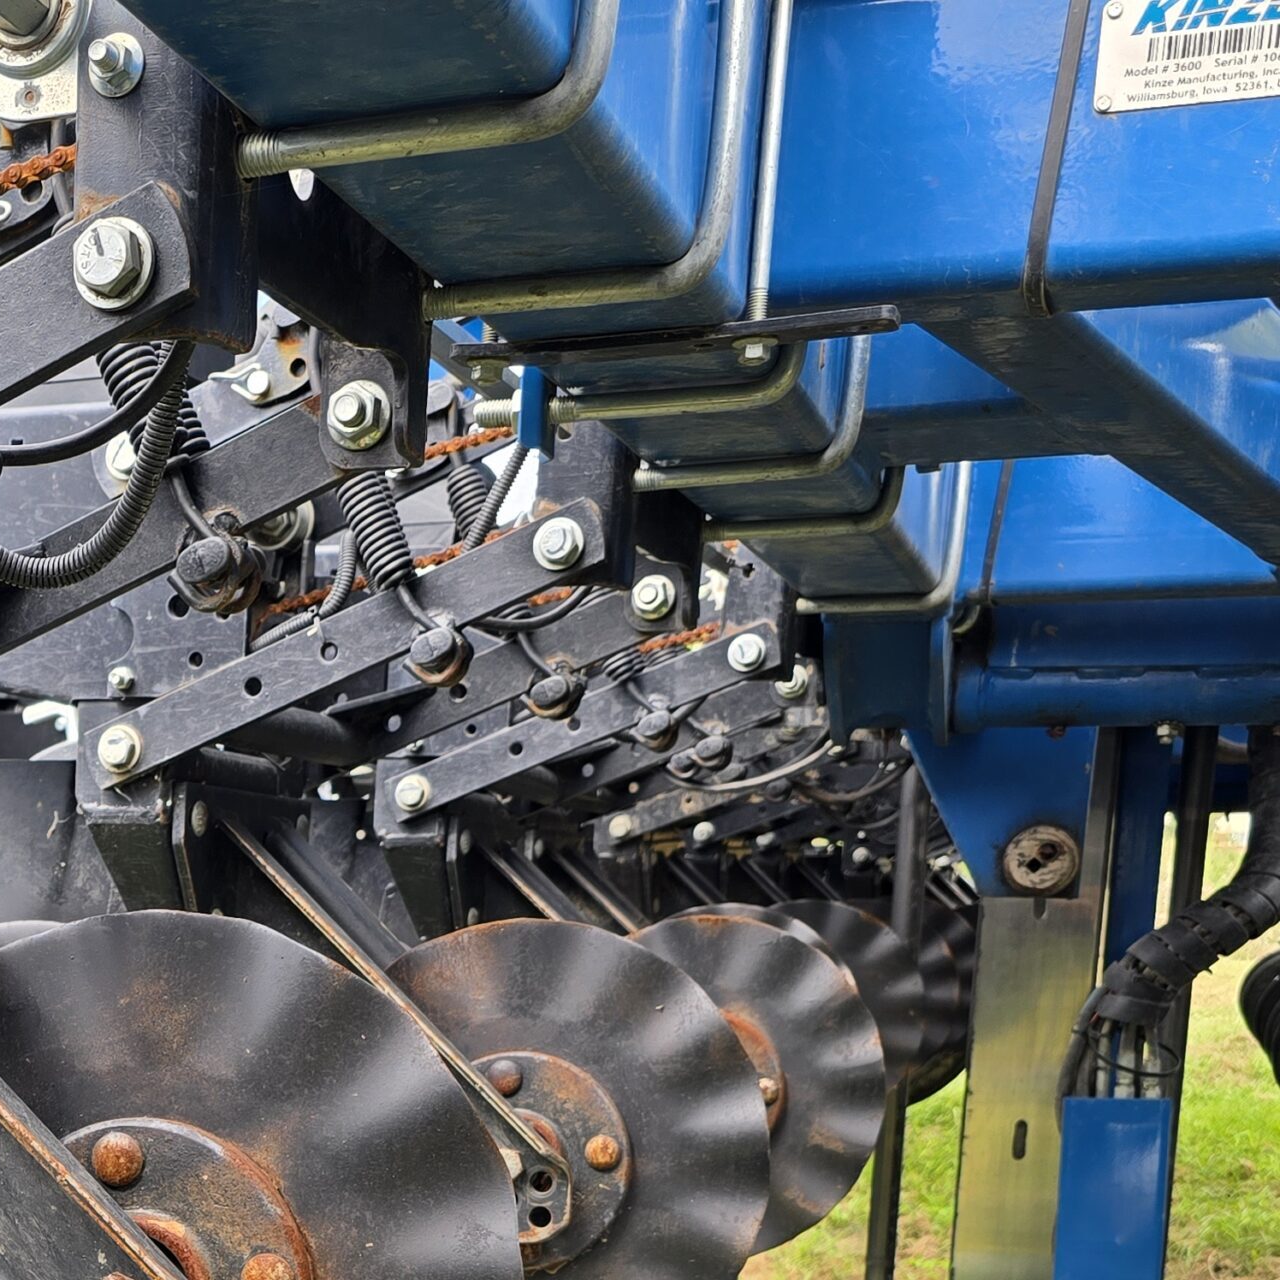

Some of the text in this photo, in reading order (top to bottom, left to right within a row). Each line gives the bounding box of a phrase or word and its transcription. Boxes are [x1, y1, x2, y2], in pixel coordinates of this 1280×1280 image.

[1124, 67, 1158, 77] Model
[1162, 65, 1169, 74] #
[1173, 61, 1202, 72] 3600
[1214, 54, 1247, 68] Serial
[1250, 54, 1258, 64] #
[1144, 78, 1174, 89] Kinze
[1176, 69, 1259, 87] Manufacturing,
[1126, 88, 1199, 103] Williamsburg,
[1202, 85, 1228, 95] Iowa
[1235, 80, 1273, 92] 52361,
